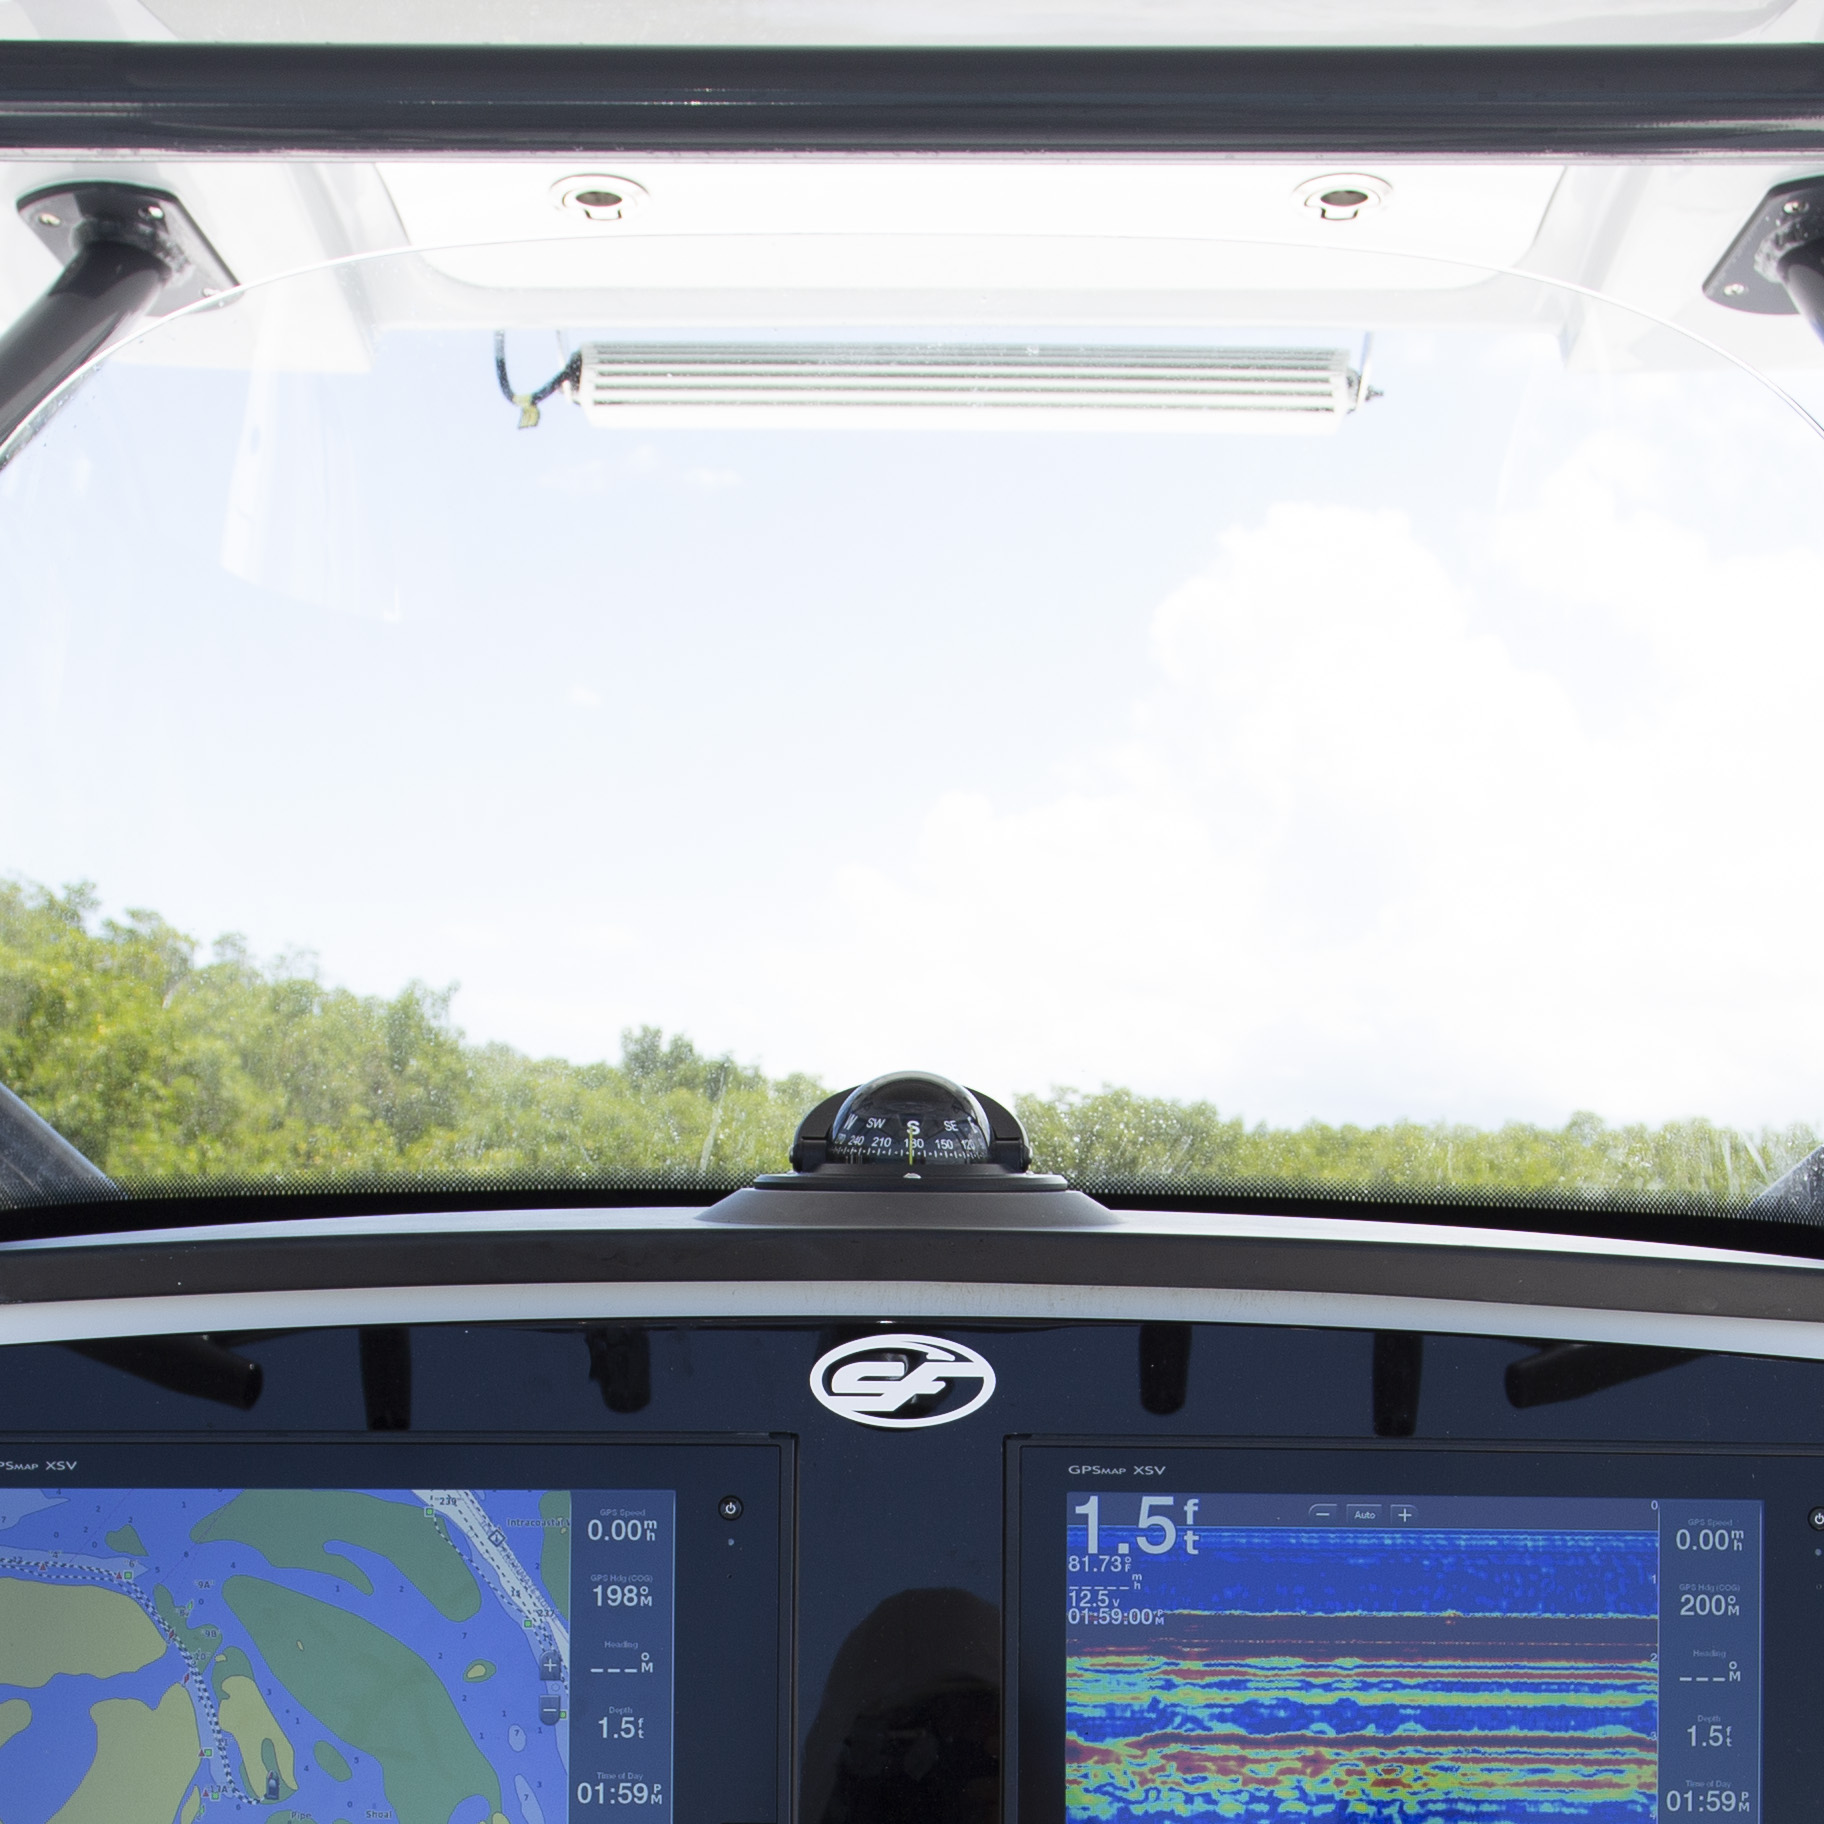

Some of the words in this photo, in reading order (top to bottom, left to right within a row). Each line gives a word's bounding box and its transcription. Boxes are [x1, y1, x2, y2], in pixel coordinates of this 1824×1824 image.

[866, 1118, 885, 1129] SW
[907, 1120, 920, 1135] S
[944, 1120, 958, 1132] SE
[848, 1135, 865, 1146] 240
[871, 1137, 892, 1147] 210
[935, 1139, 954, 1149] 150
[46, 1461, 77, 1471] XSV
[1133, 1466, 1166, 1475] XSV
[1353, 1509, 1376, 1521] Auto
[587, 1519, 642, 1541] 0.00
[1075, 1495, 1176, 1555] 1.5
[1676, 1529, 1729, 1551] 0.00
[1068, 1555, 1122, 1572] 81.73
[593, 1585, 638, 1607] 198
[1069, 1590, 1109, 1607] 12.5
[1680, 1594, 1726, 1616] 200
[1068, 1608, 1153, 1625] 01:59:00
[609, 1706, 633, 1716] Depth
[598, 1717, 635, 1738] 1.5
[1687, 1725, 1723, 1747] 1.5
[577, 1782, 649, 1805] 01:59
[1666, 1790, 1737, 1812] 01:59
[366, 1810, 392, 1819] Shoal
